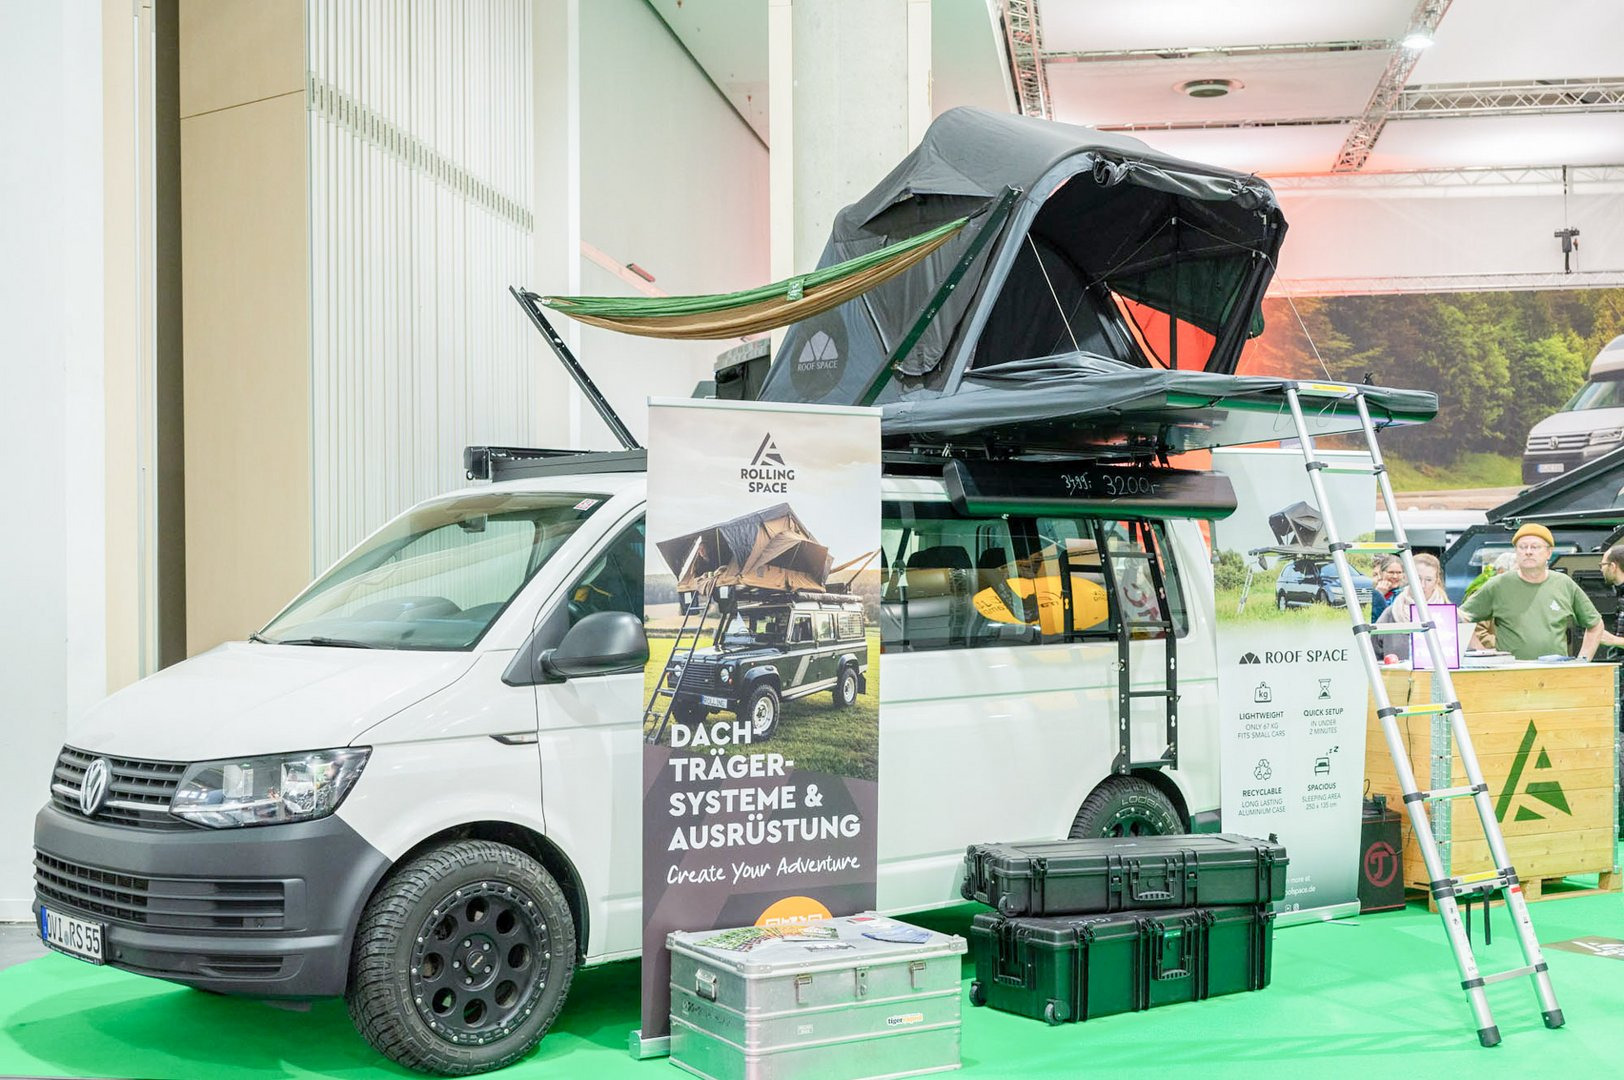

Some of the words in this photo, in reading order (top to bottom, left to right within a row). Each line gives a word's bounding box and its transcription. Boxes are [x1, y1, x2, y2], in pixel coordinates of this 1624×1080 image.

[797, 363, 815, 371] ROOF
[816, 361, 838, 369] SPACE
[740, 468, 795, 481] ROLLING
[749, 482, 788, 493] SPACE
[1265, 650, 1303, 664] ROOF
[1306, 649, 1349, 662] SPACE
[1258, 690, 1269, 699] kg
[1239, 711, 1284, 720] LIGHTWEIGHT
[1303, 709, 1324, 717] QUICK
[1245, 723, 1262, 731] ONLY
[1251, 731, 1271, 739] SMALL
[669, 748, 795, 782] TRÄGER-
[1307, 782, 1337, 791] SPACIOUS
[1242, 787, 1282, 797] RECYCLABLE
[668, 785, 796, 817] SYSTEME
[804, 784, 823, 808] &
[1302, 794, 1326, 803] SLEEPING
[1327, 792, 1341, 800] AREA
[1241, 799, 1259, 808] LONG
[1260, 798, 1283, 807] LASTING
[1238, 807, 1272, 816] ALUMINIUM
[1272, 806, 1286, 814] CASE
[667, 813, 861, 851] AUSRÜSTUNG
[667, 864, 726, 885] Create
[731, 862, 771, 884] Your
[776, 855, 860, 877] Adventure
[85, 926, 100, 954] 55
